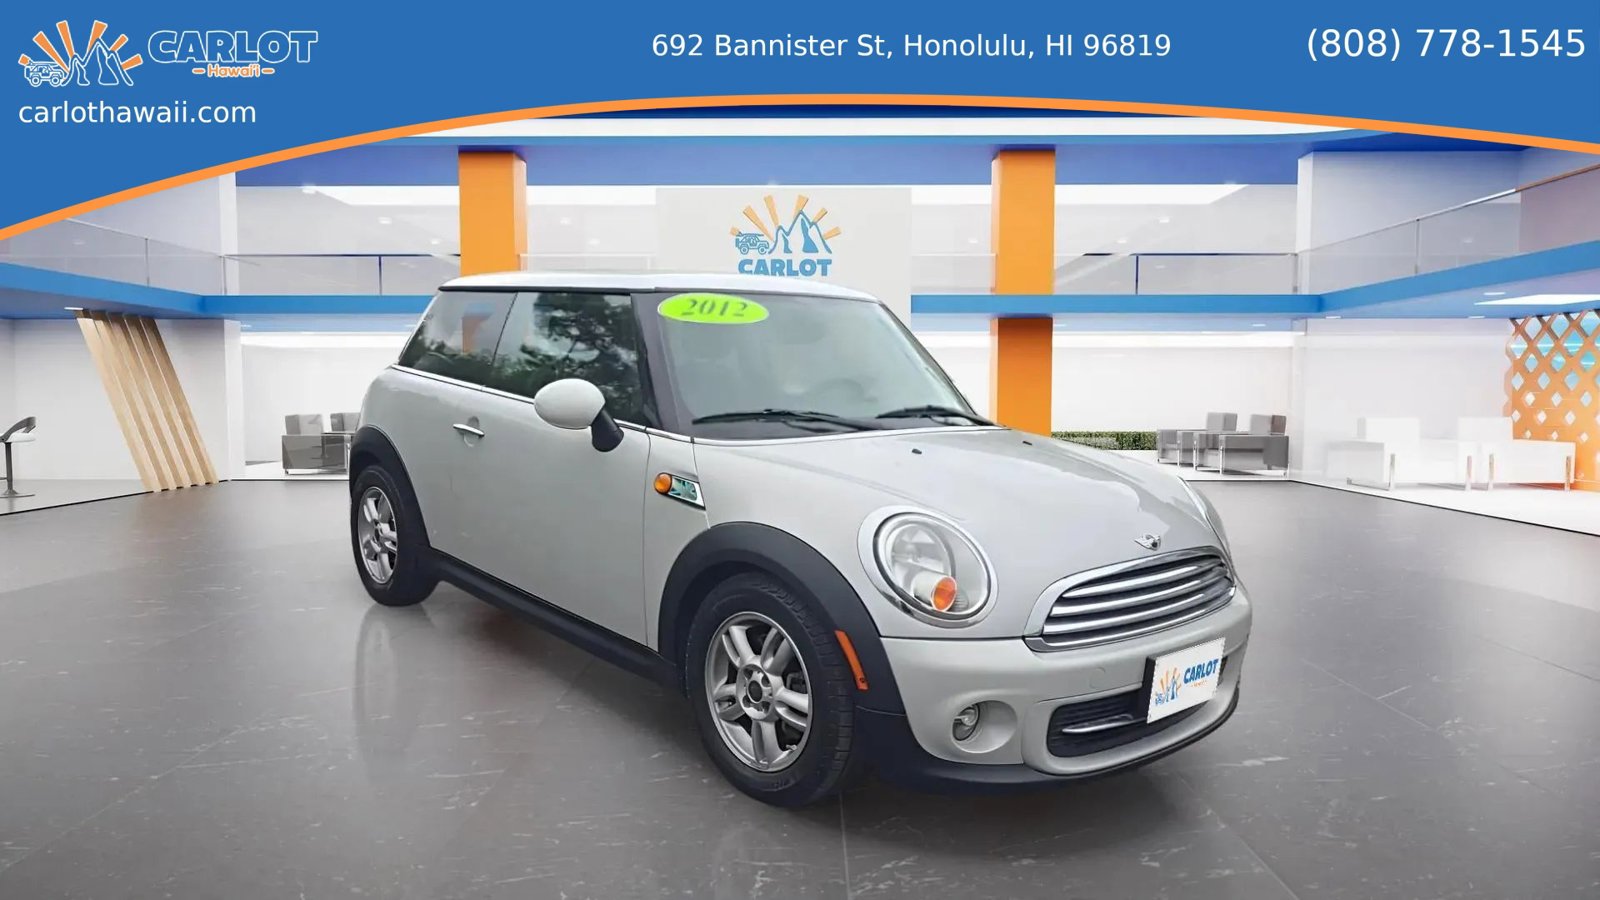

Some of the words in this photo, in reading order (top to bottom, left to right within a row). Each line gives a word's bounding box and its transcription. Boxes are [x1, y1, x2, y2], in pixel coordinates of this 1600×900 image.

[738, 258, 832, 276] CARLOT
[681, 298, 748, 317] 2012
[1183, 658, 1219, 684] CARLOT
